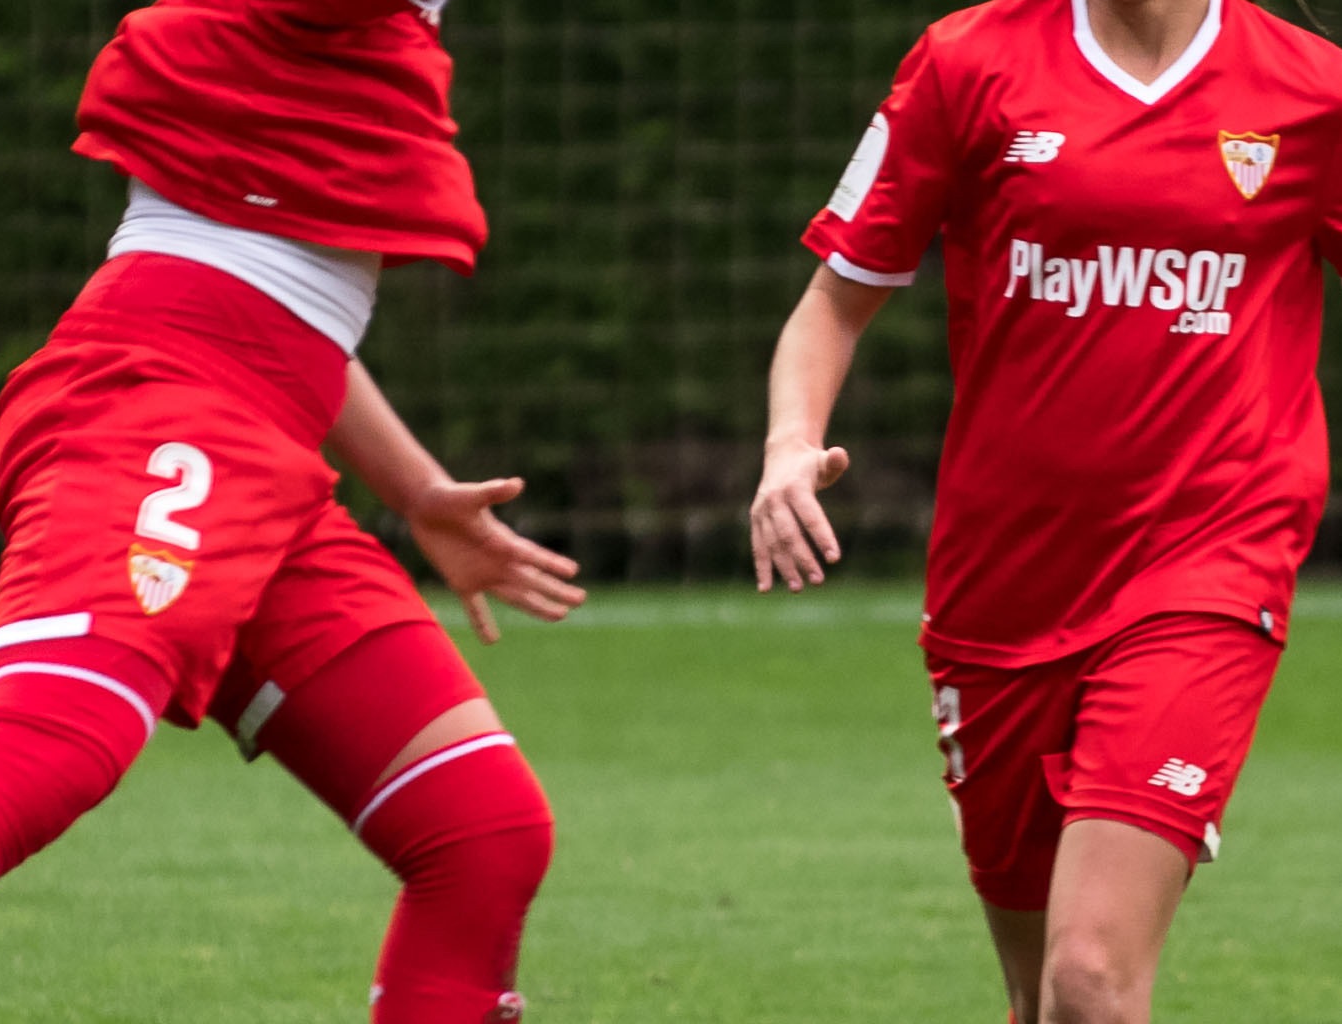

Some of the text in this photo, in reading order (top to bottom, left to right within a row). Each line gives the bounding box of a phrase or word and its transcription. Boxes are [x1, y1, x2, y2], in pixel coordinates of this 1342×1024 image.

[1003, 238, 1247, 318] PlayWSOP
[1169, 311, 1232, 335] .com
[134, 441, 213, 551] 2
